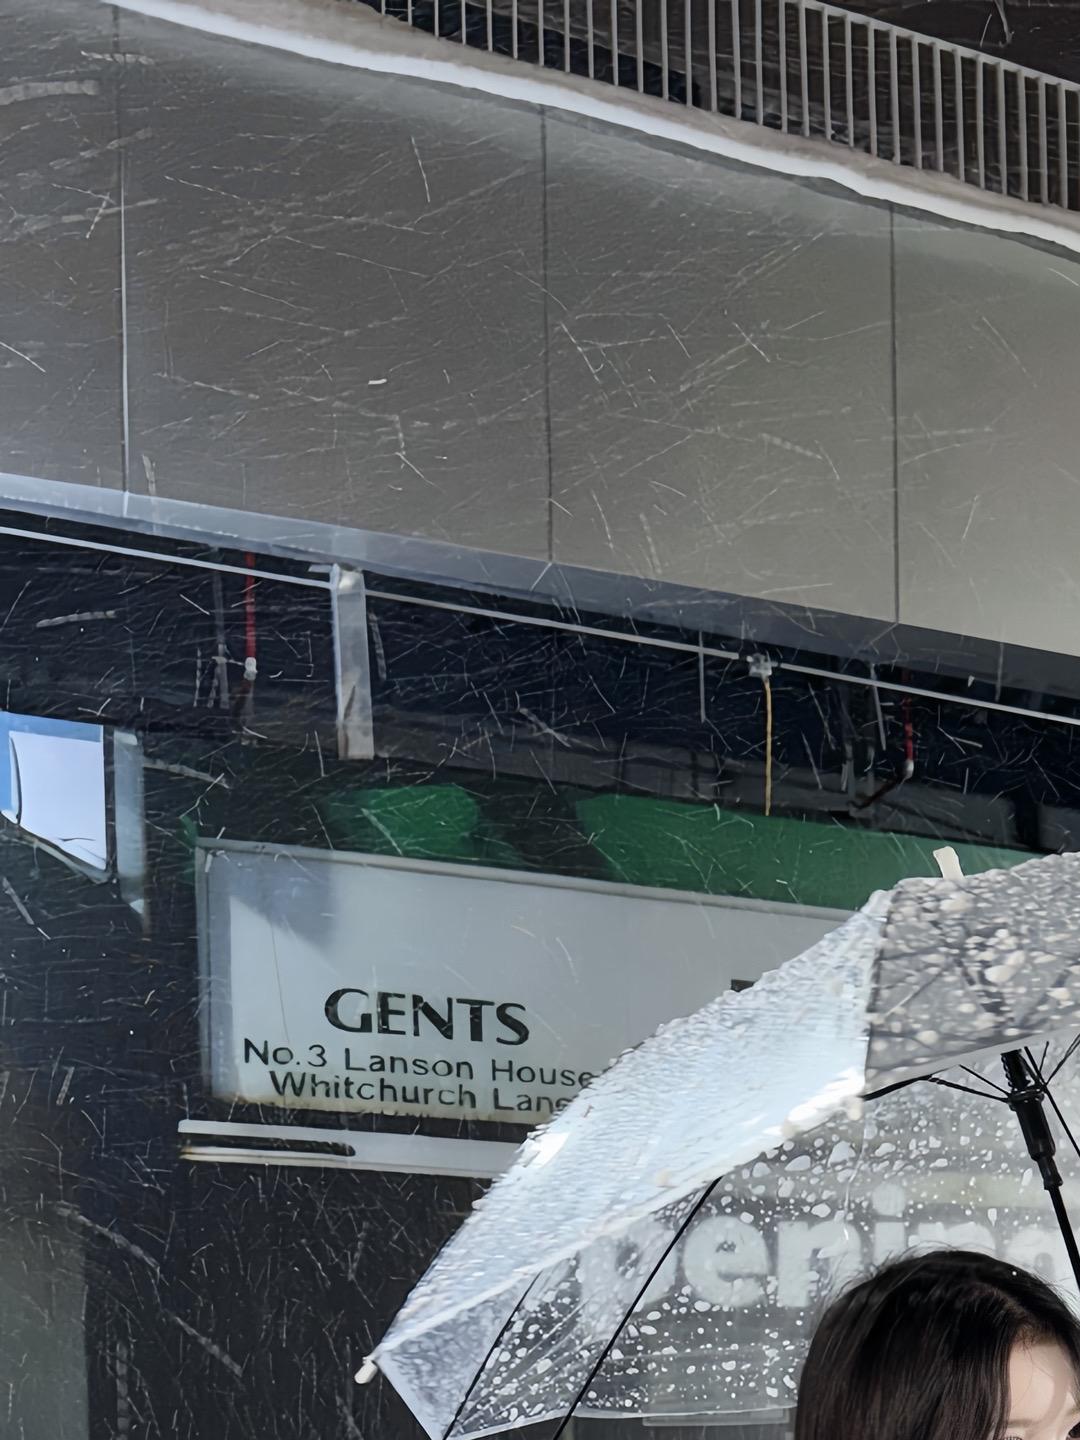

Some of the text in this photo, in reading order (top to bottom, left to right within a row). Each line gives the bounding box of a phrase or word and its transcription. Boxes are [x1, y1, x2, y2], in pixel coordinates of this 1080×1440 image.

[324, 988, 530, 1046] GENTS
[344, 1046, 474, 1081] Lanson
[491, 1058, 600, 1089] House
[269, 1070, 477, 1109] Whitchurch
